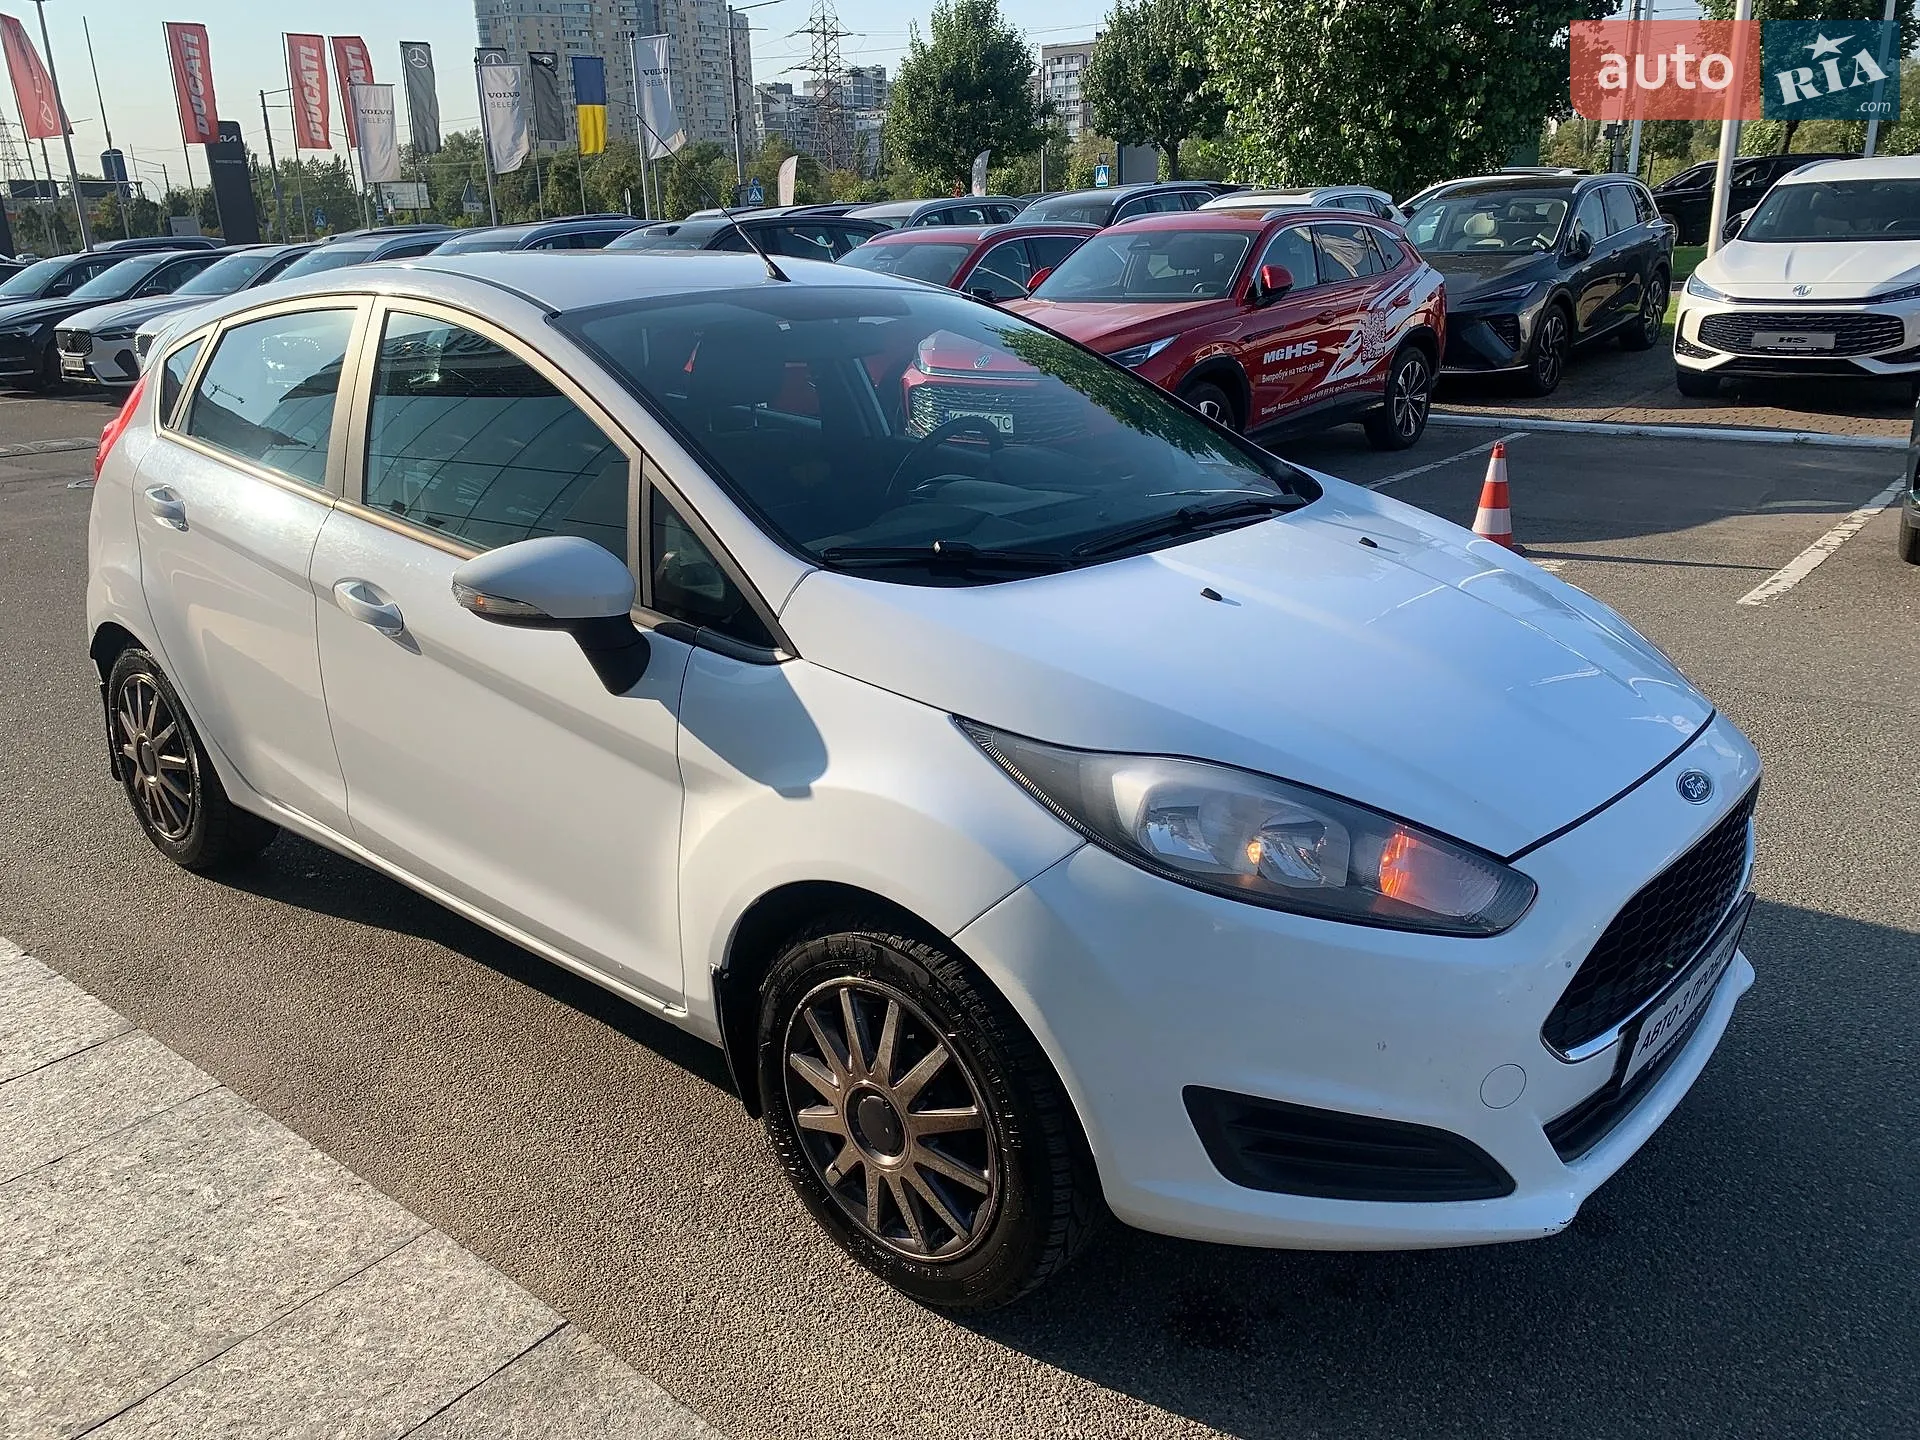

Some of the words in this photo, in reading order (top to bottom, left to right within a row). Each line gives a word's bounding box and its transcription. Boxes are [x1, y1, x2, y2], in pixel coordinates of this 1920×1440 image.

[181, 32, 210, 135] DUCATI
[345, 45, 367, 83] ATI
[300, 46, 325, 141] DUCATI
[487, 91, 520, 99] VOLVO
[1684, 775, 1708, 799] Ford
[1637, 1003, 1680, 1057] АВТО
